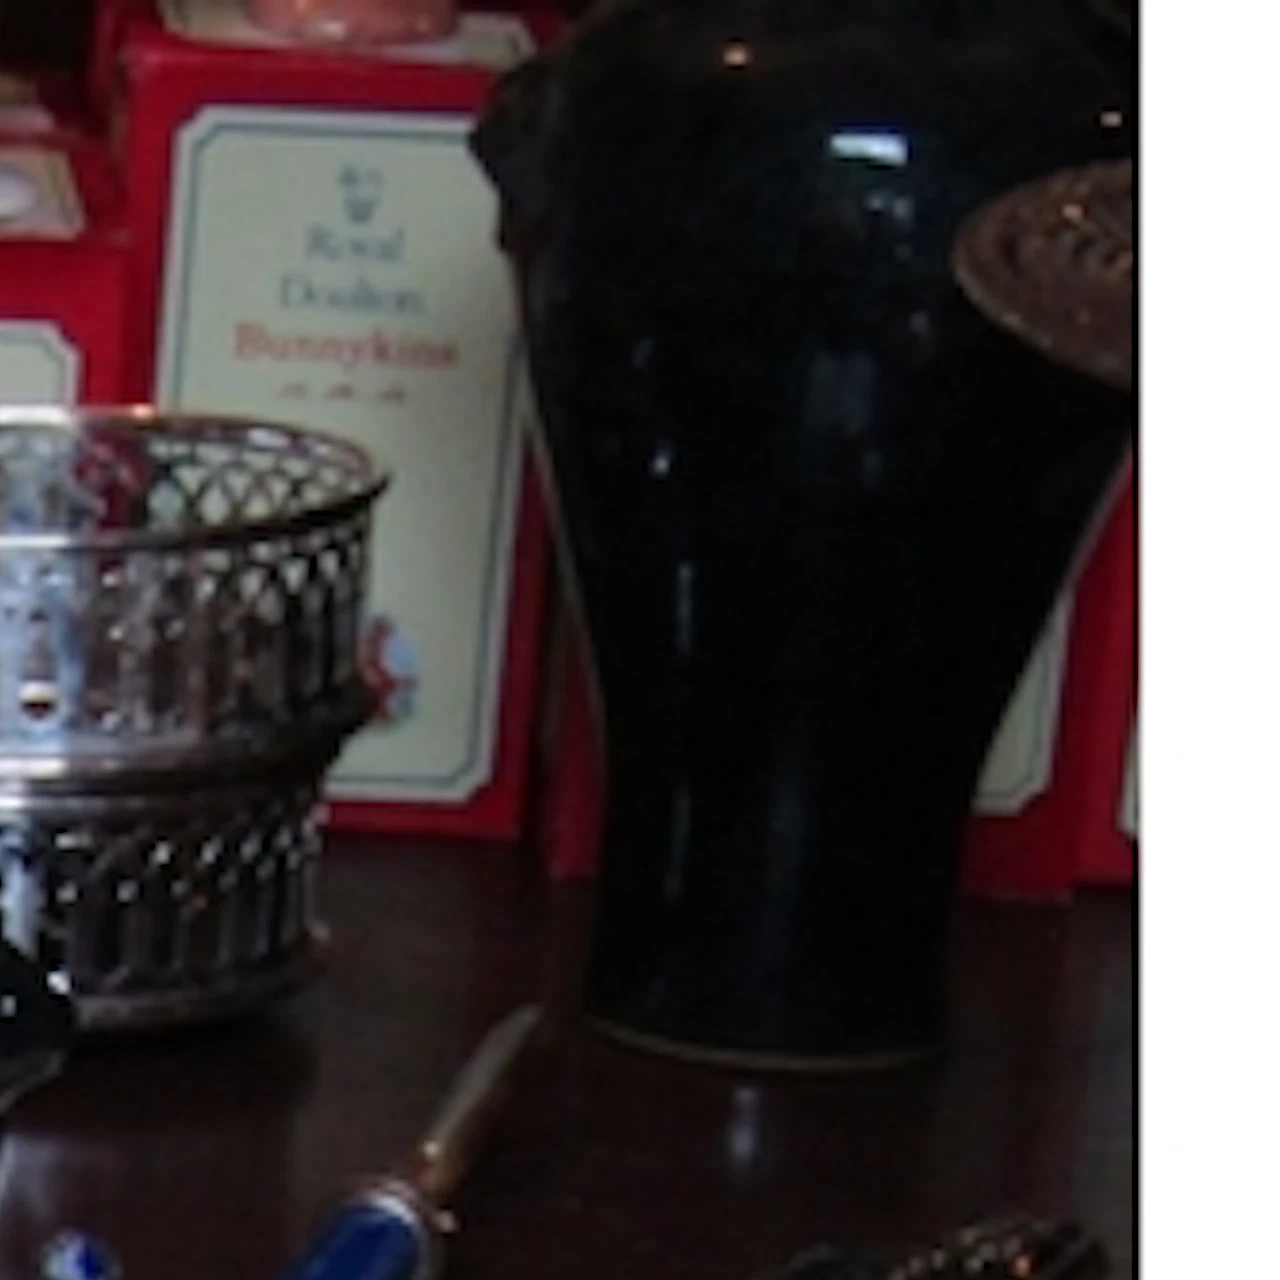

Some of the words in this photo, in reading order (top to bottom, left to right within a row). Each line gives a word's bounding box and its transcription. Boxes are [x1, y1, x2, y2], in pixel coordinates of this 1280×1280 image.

[303, 222, 406, 264] Royal
[278, 272, 426, 318] Doulton
[232, 318, 460, 374] Bunnykins
